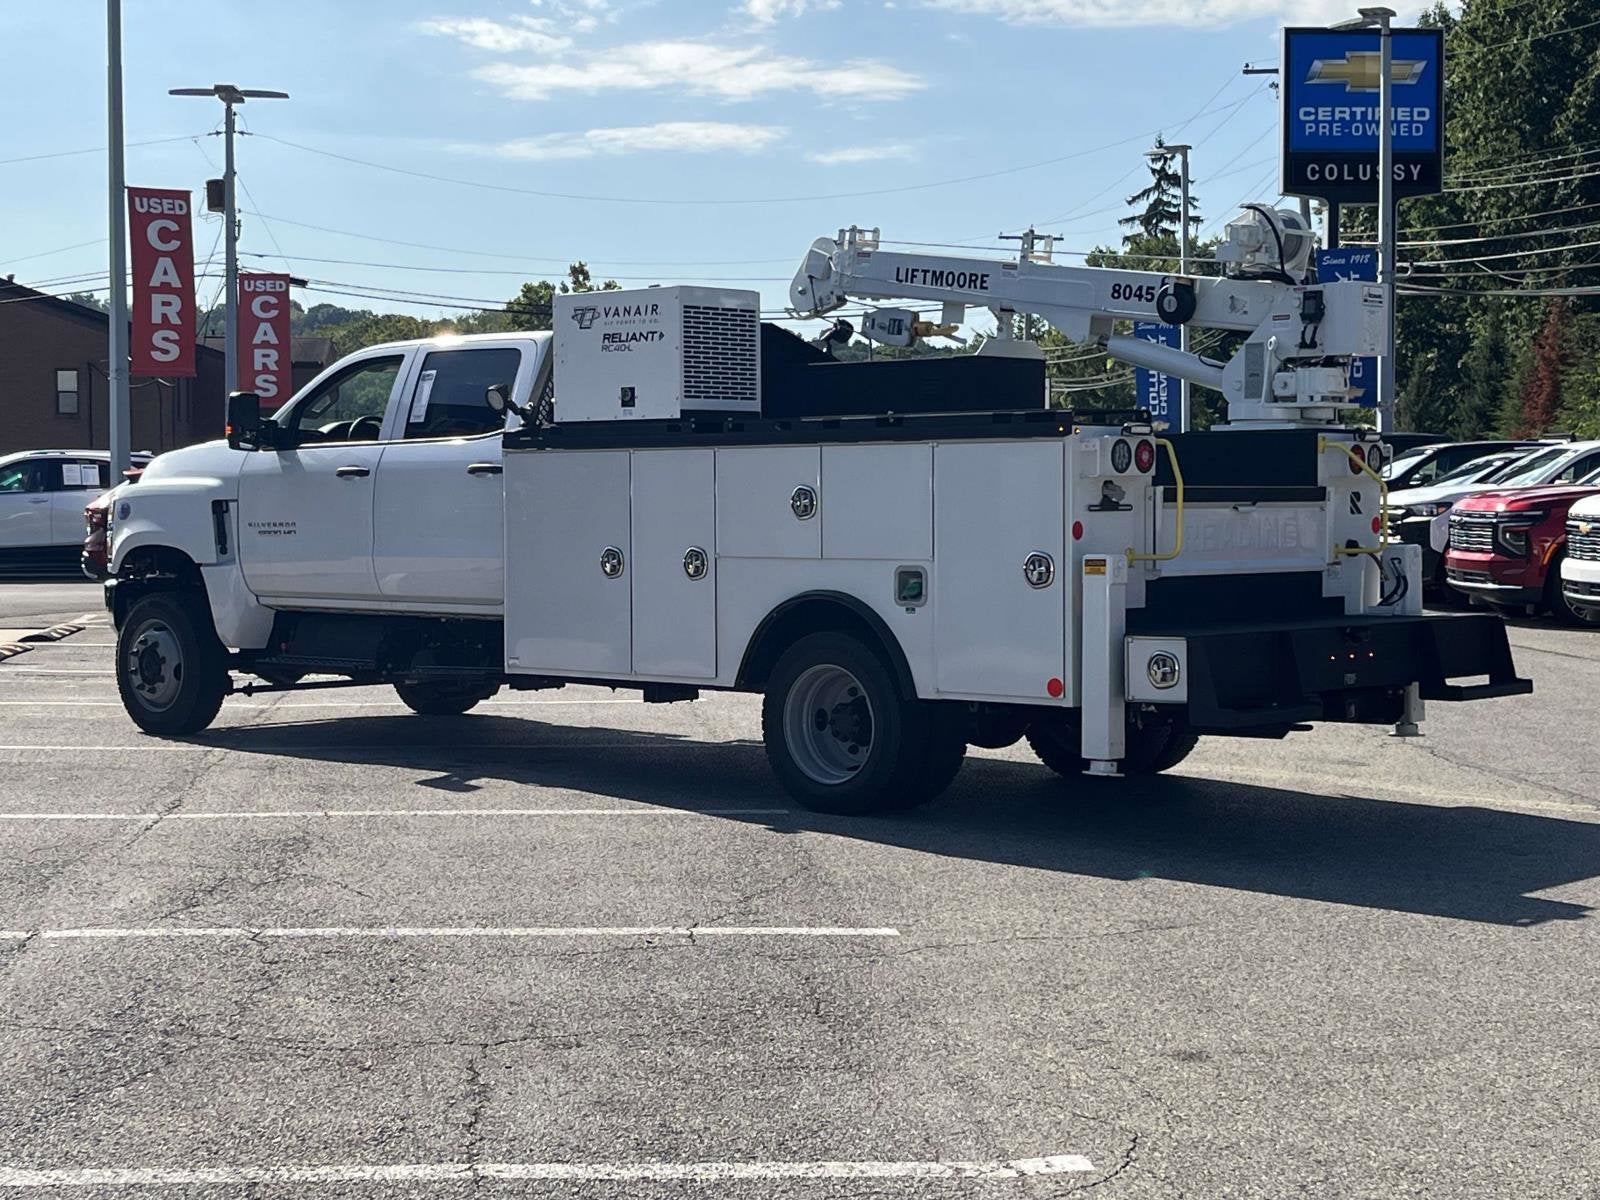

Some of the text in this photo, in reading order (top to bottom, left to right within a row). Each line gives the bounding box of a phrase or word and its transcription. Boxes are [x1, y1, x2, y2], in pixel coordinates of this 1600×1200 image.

[134, 196, 188, 216] USED
[1322, 254, 1371, 266] Since 1918
[243, 279, 287, 293] USED
[895, 266, 990, 291] LIFTMOORE
[146, 218, 183, 363] CARS
[1111, 283, 1156, 303] 8045
[603, 304, 659, 318] VANAIR
[251, 295, 280, 398] CARS
[602, 331, 658, 343] RELIANT
[1147, 334, 1160, 416] COLUY
[1159, 335, 1168, 416] CHEVT
